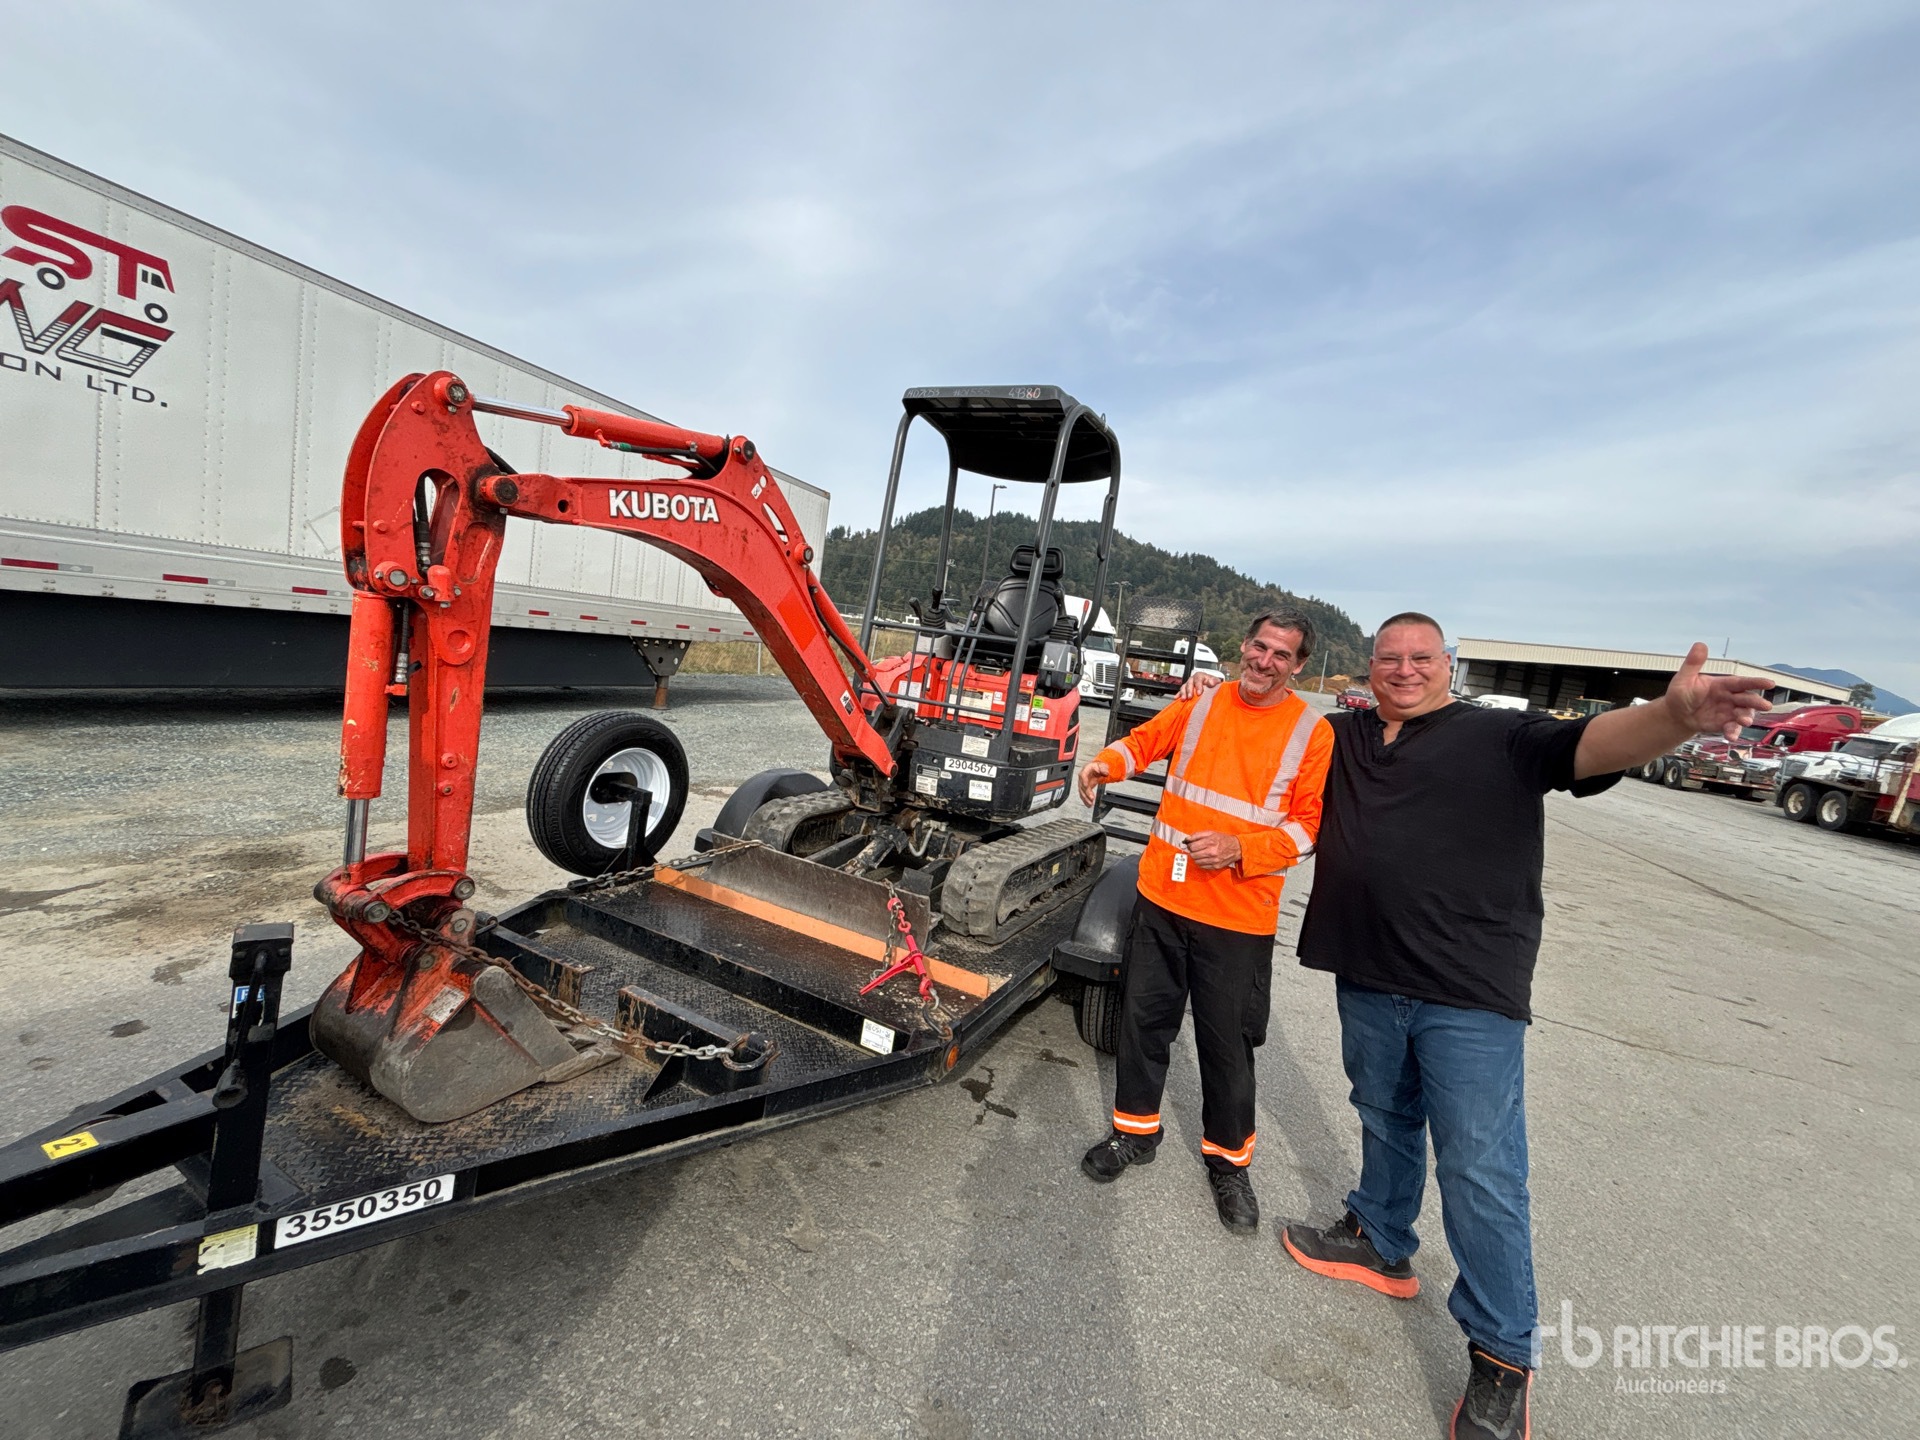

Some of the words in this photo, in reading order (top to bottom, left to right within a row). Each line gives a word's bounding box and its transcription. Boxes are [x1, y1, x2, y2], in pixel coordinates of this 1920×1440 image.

[86, 374, 168, 408] LTD.
[608, 488, 720, 523] KUBOTA
[948, 758, 994, 775] 2904567
[284, 1179, 442, 1239] 3550350
